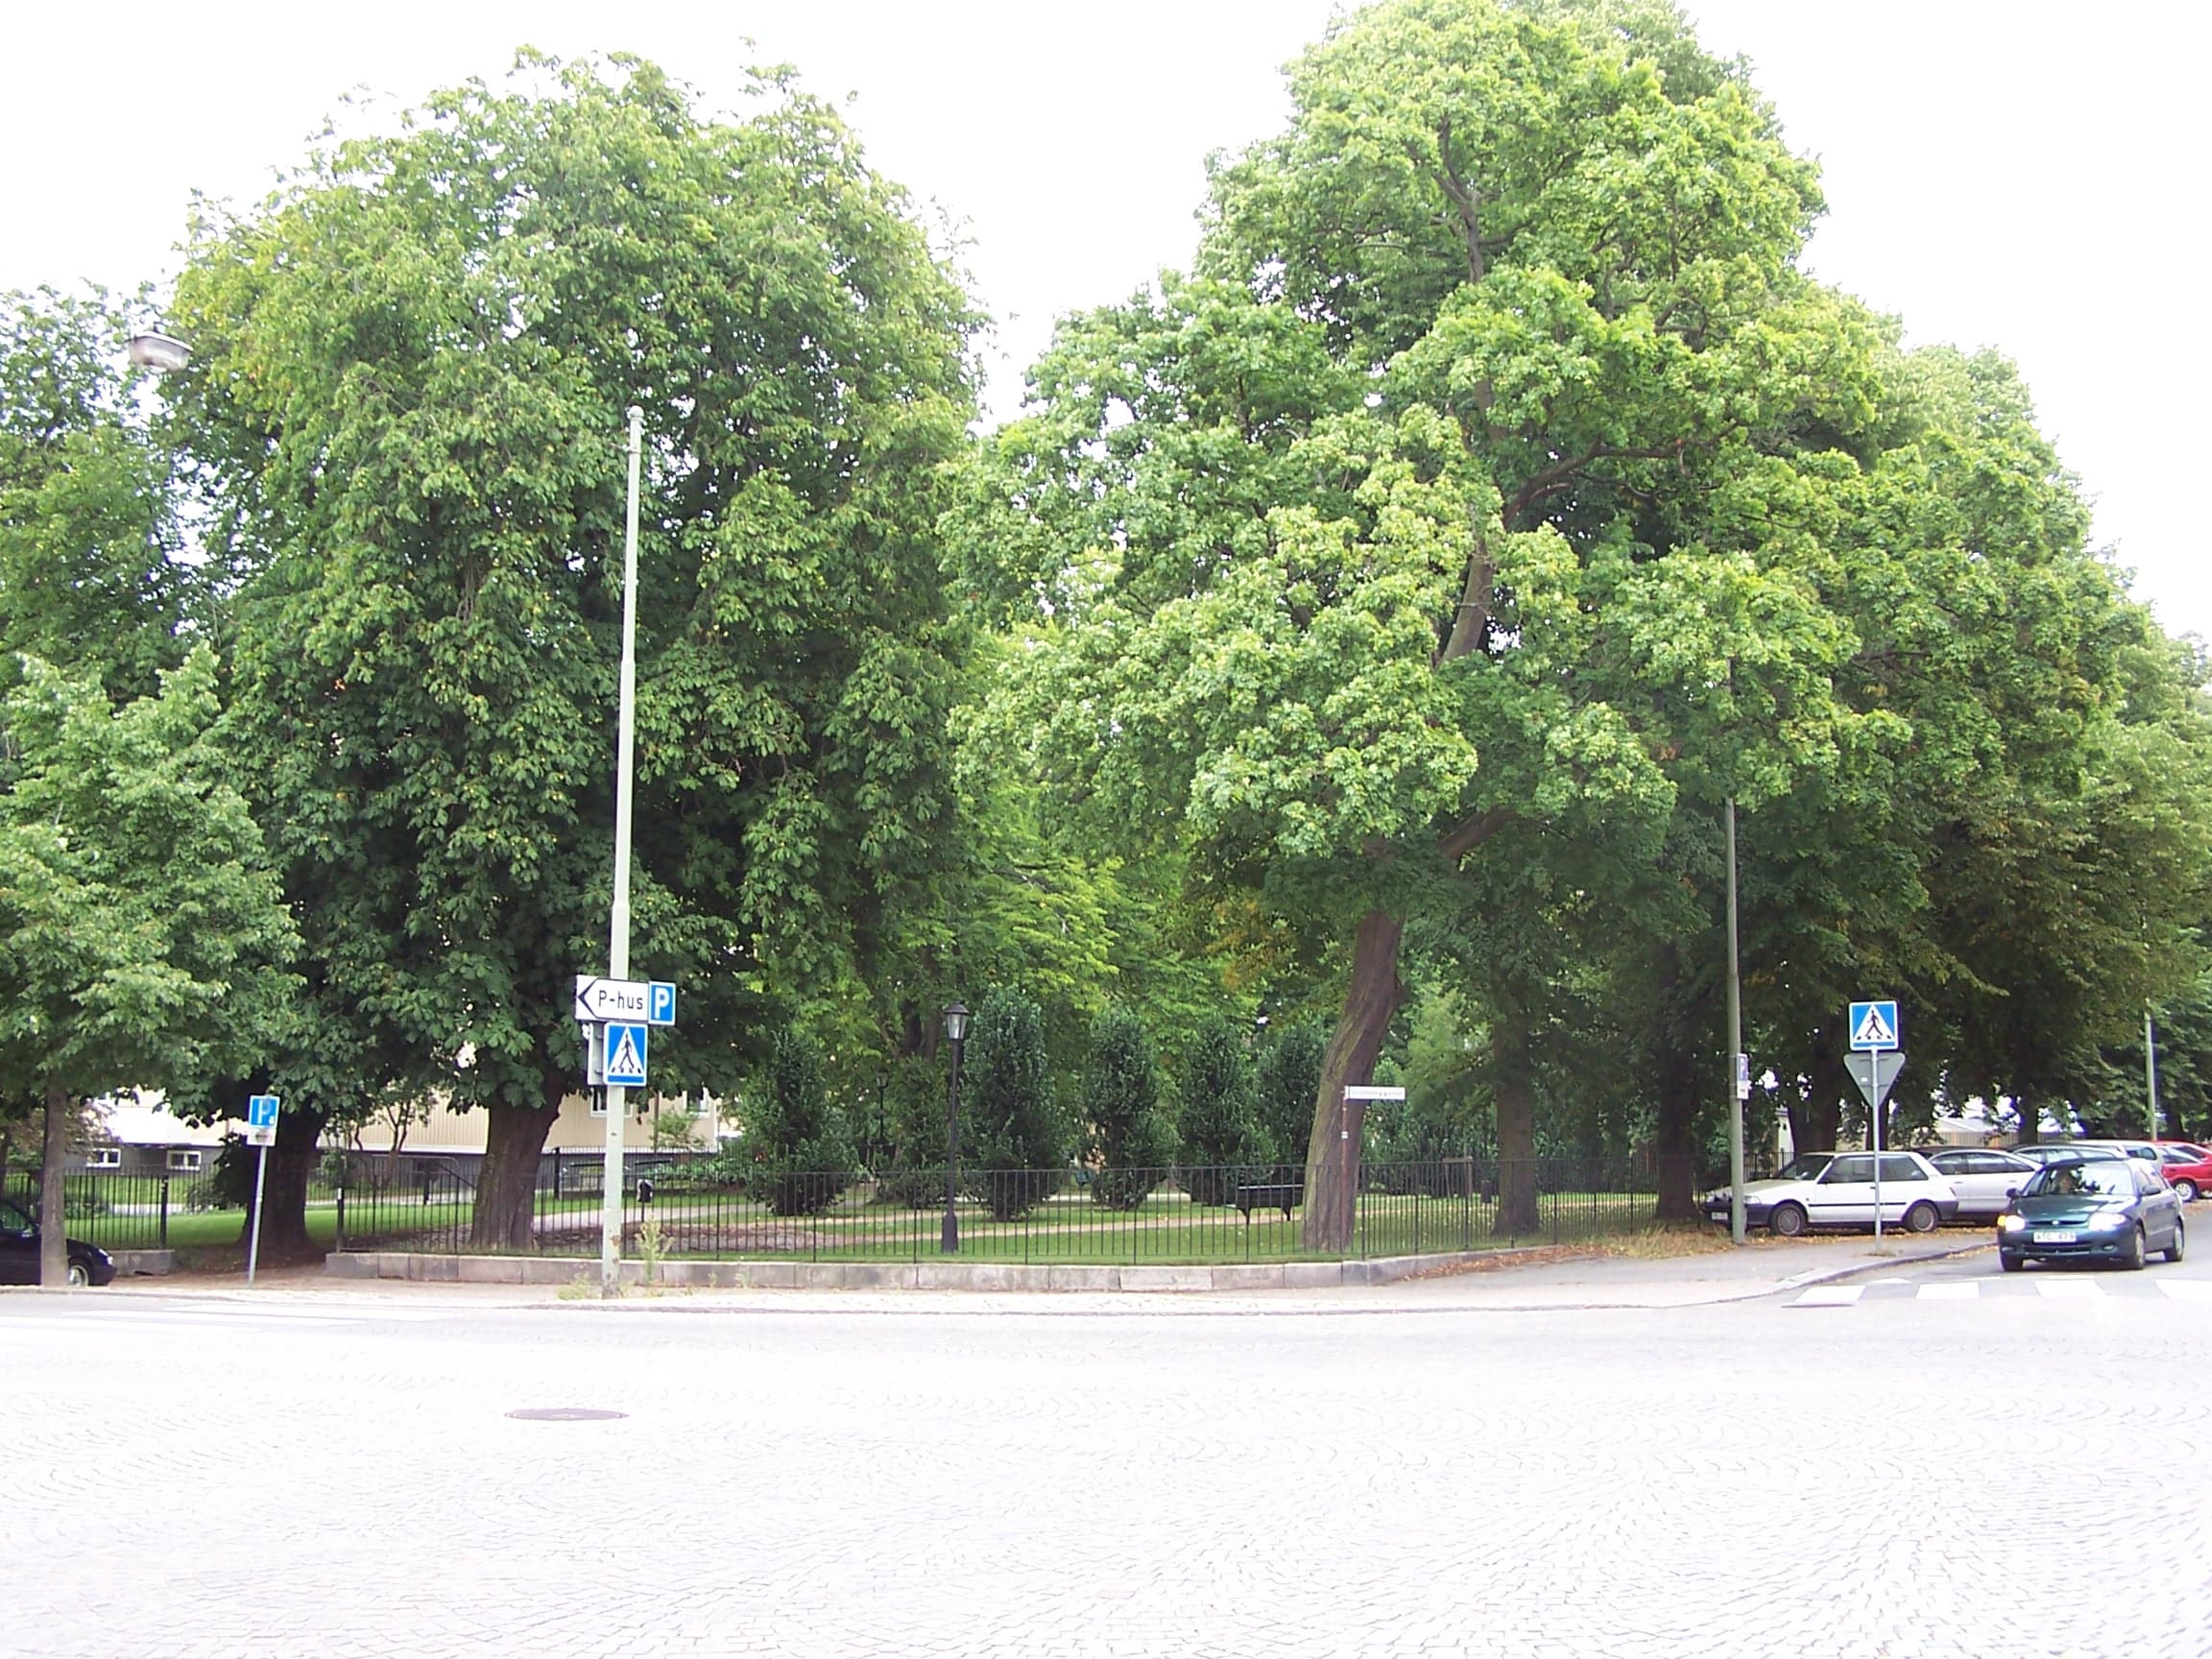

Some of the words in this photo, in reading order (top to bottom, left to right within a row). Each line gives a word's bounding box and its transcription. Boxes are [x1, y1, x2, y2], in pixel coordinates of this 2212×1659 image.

[598, 990, 643, 1010] P-hus
[655, 987, 670, 1019] P
[257, 1099, 272, 1123] P
